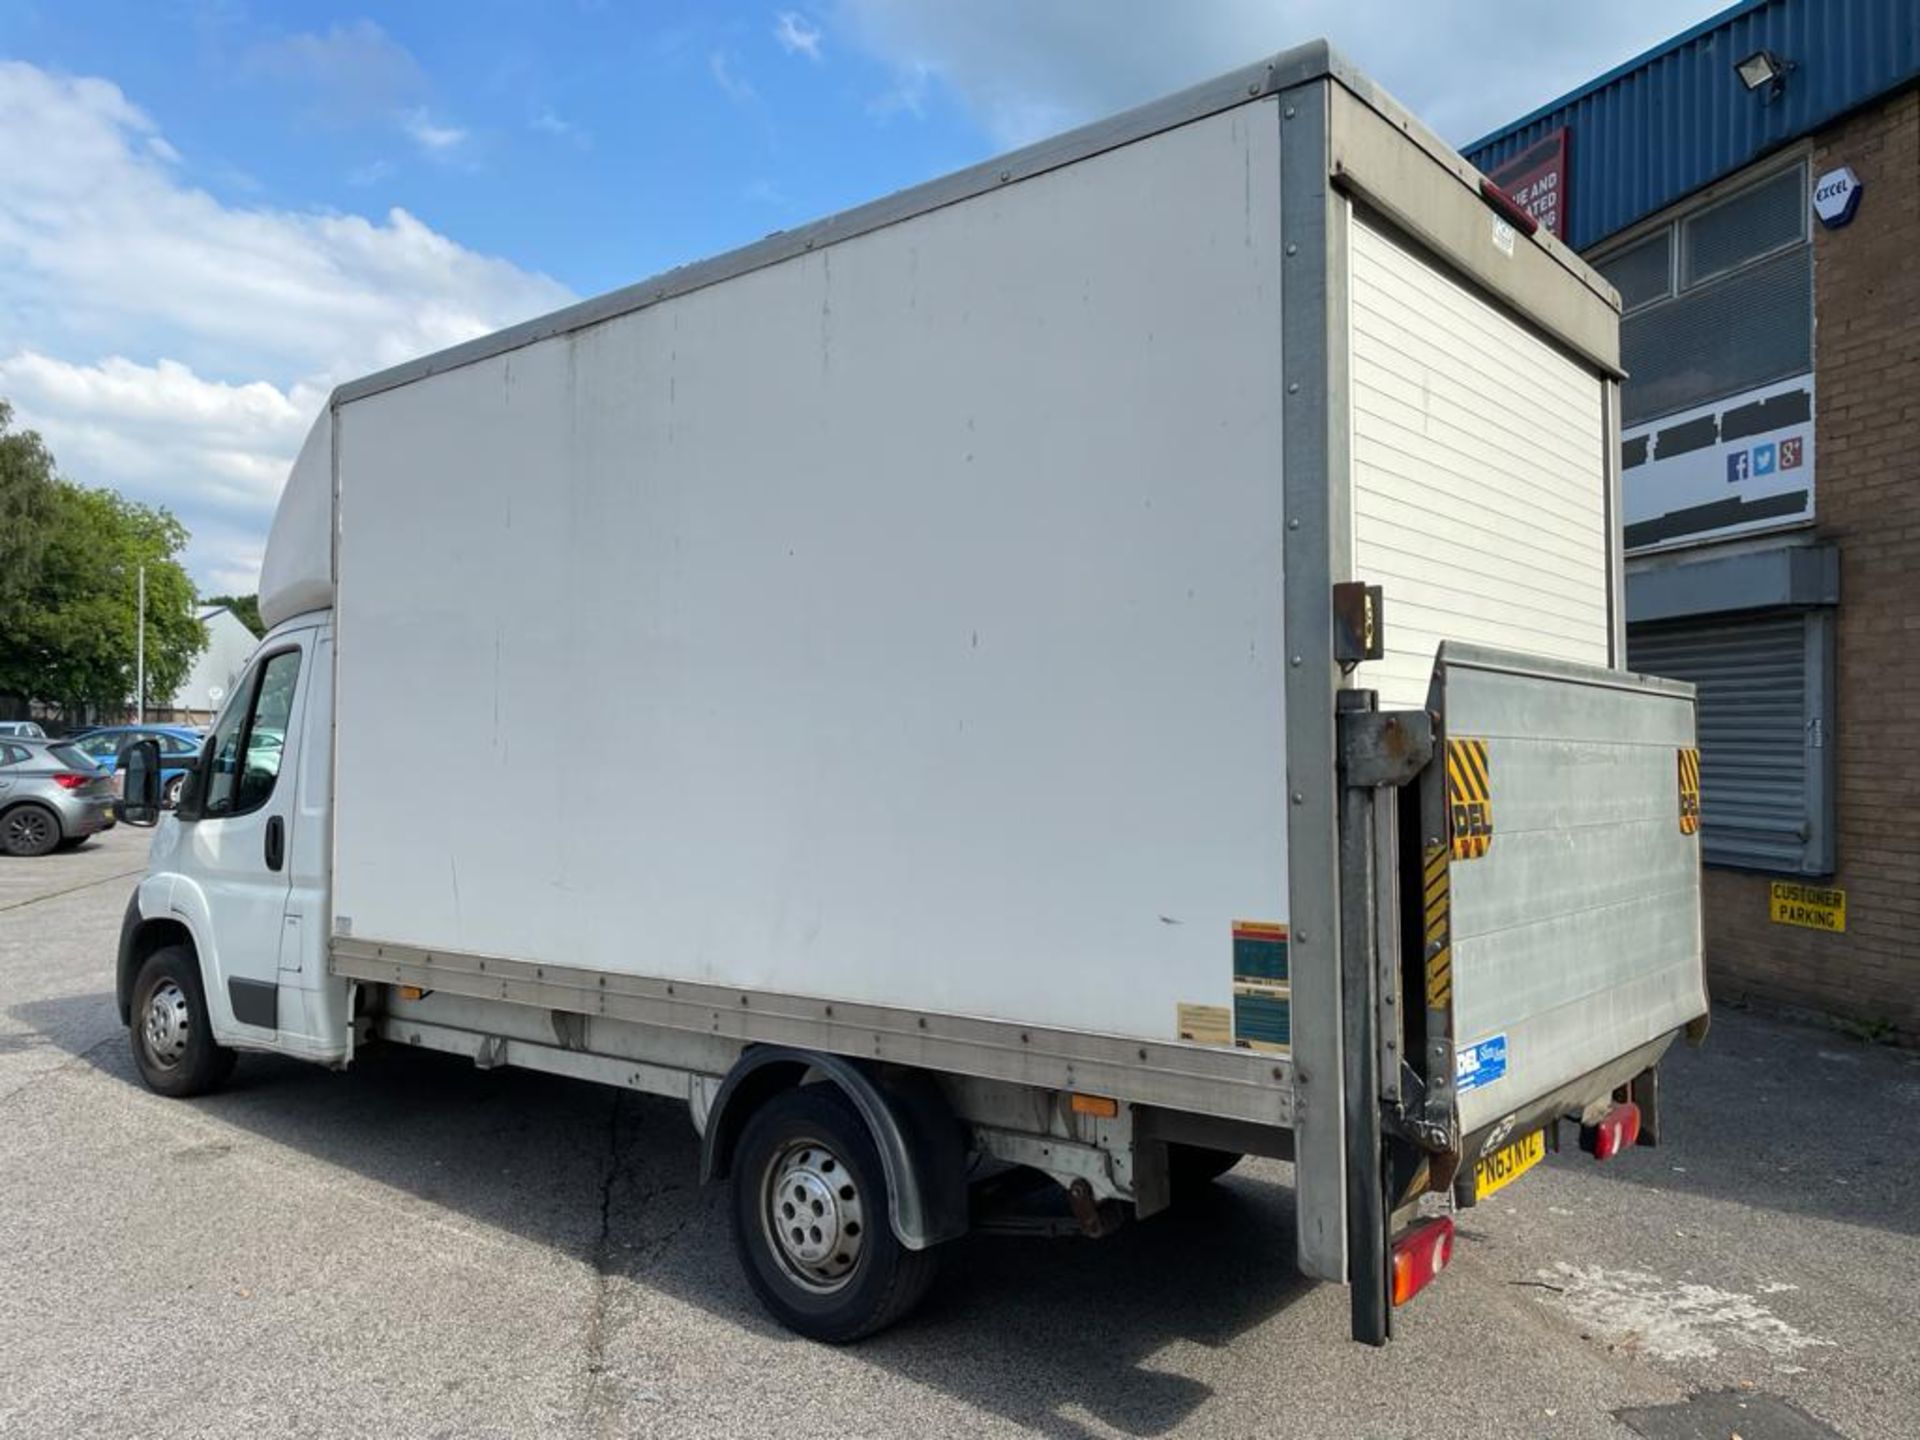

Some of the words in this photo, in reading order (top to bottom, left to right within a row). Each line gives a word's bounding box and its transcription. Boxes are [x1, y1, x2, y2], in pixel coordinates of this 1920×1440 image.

[1529, 172, 1557, 200] AND
[1816, 179, 1848, 202] EXCEL
[1454, 803, 1492, 838] DEL
[1773, 884, 1843, 909] CUSTOMER
[1780, 904, 1835, 928] PARKING
